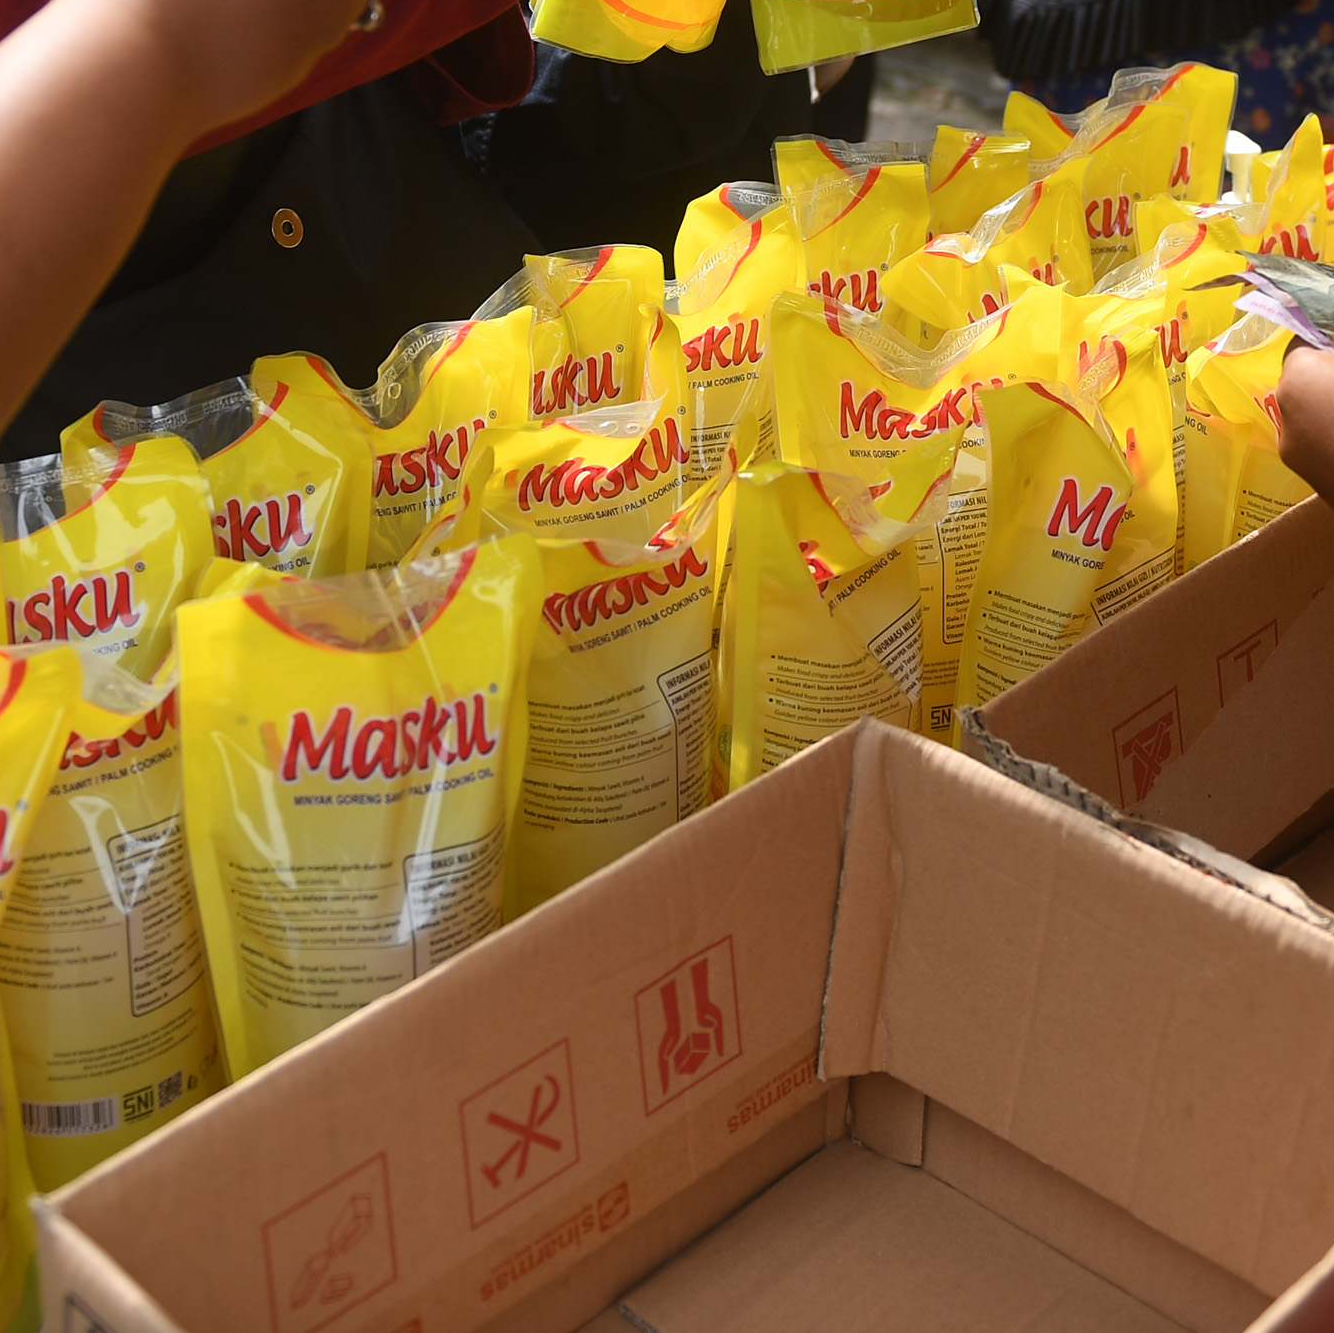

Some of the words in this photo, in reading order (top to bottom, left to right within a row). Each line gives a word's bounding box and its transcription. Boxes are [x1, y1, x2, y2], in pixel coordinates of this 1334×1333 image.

[682, 319, 763, 372] sku
[693, 379, 712, 389] PALM
[714, 374, 745, 386] COOKING
[1197, 422, 1208, 436] OIL
[850, 449, 871, 458] MINYAK
[535, 517, 562, 527] MINYAK
[563, 513, 595, 524] GORENG
[596, 508, 619, 519] SAWIT
[625, 498, 647, 512] PALM
[648, 478, 680, 502] COOKING
[1247, 490, 1272, 503] Membuat
[393, 504, 416, 515] SAWIT
[423, 497, 446, 509] PALM
[1124, 509, 1135, 519] OIL
[214, 494, 312, 562] sku
[941, 525, 961, 535] Energi
[962, 523, 976, 531] Total
[943, 535, 961, 543] Energi
[962, 532, 973, 540] dari
[944, 545, 963, 553] Lemak
[1051, 548, 1080, 565] MINYAK
[296, 556, 311, 567] OIL
[836, 583, 855, 603] PALM
[854, 558, 888, 590] COOKING
[887, 549, 901, 565] OIL
[947, 592, 967, 600] Protein
[1097, 586, 1127, 605] INFORMASI
[1126, 577, 1138, 591] NILAI
[994, 590, 1021, 604] Membuat
[1021, 597, 1046, 610] masakan
[611, 624, 633, 640] SAWIT
[637, 614, 659, 630] PALM
[660, 592, 699, 618] COOKING
[700, 586, 712, 597] OIL
[1008, 604, 1019, 614] food
[1020, 608, 1034, 621] crispy
[988, 613, 1010, 626] Terbuat
[1011, 618, 1022, 629] dari
[1022, 622, 1037, 635] buah
[123, 638, 138, 649] OIL
[1011, 632, 1025, 641] from
[983, 637, 1002, 650] Warna
[1003, 642, 1024, 657] kuning
[778, 654, 810, 667] Membuat
[812, 660, 840, 670] masakan
[666, 666, 699, 689] INFORMASI
[796, 668, 810, 677] food
[776, 676, 801, 688] Terbuat
[802, 680, 815, 690] dari
[817, 683, 834, 692] buah
[775, 698, 796, 710] Warna
[797, 704, 821, 714] kuning
[822, 704, 856, 714] keemasan
[283, 693, 495, 782] Masku
[579, 747, 613, 758] keemasan
[63, 777, 92, 794] SAWIT
[101, 768, 127, 785] PALM
[130, 748, 173, 774] COOKING
[294, 795, 334, 806] MINYAK
[336, 794, 381, 806] GORENG
[435, 771, 476, 791] COOKING
[478, 768, 494, 780] OIL
[123, 1090, 154, 1117] SNI
[727, 1061, 816, 1134] inarmas
[479, 1214, 595, 1302] sinarmas
